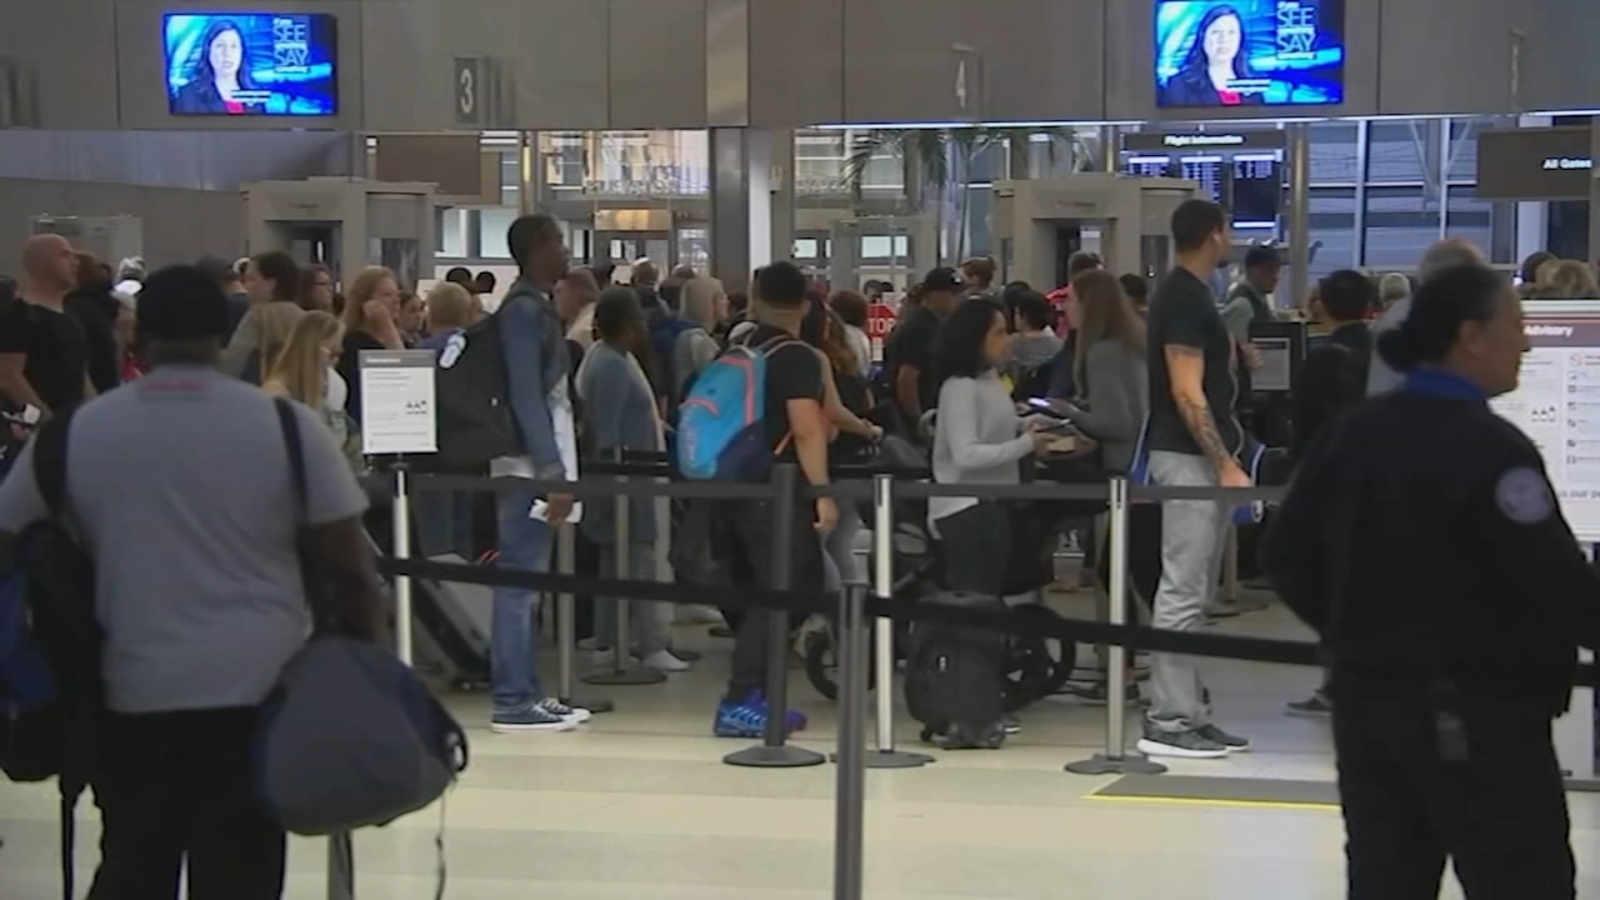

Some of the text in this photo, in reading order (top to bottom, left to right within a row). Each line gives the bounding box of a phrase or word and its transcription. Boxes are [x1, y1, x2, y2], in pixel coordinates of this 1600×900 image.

[1276, 7, 1315, 27] SEE
[272, 24, 306, 42] SEE
[1276, 33, 1316, 52] SAY
[273, 48, 309, 66] SAY
[460, 68, 474, 114] 3
[1542, 158, 1593, 169] All Gates
[867, 317, 896, 333] TOP
[1523, 324, 1575, 338] Advisory
